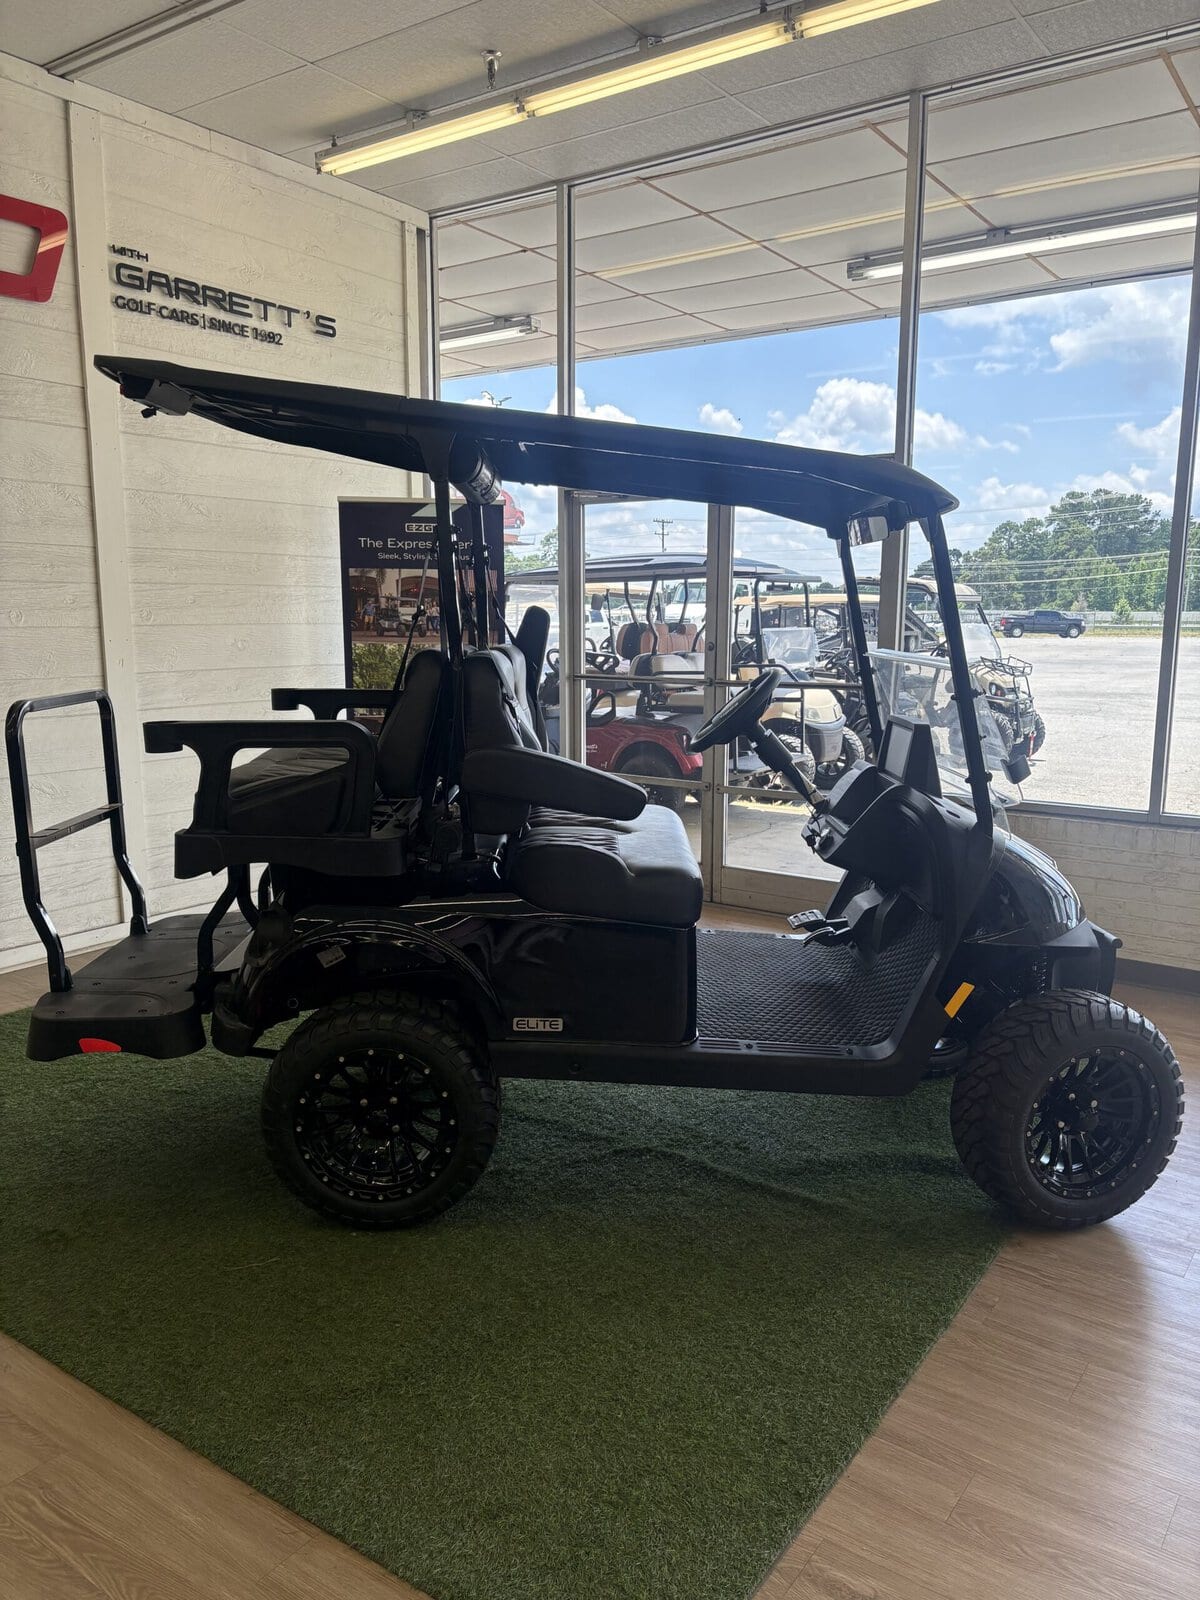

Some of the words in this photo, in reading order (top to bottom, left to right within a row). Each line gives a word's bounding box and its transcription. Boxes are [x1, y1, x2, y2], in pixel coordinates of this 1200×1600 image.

[108, 244, 149, 262] WITH
[115, 262, 337, 338] GARRETT'S
[114, 295, 157, 316] GOLF
[158, 305, 200, 327] CARS
[207, 317, 250, 338] SINCE
[251, 327, 284, 346] 1992
[405, 523, 438, 533] EZG
[358, 537, 384, 549] The
[387, 537, 438, 551] Expres
[377, 552, 402, 561] Sleek,
